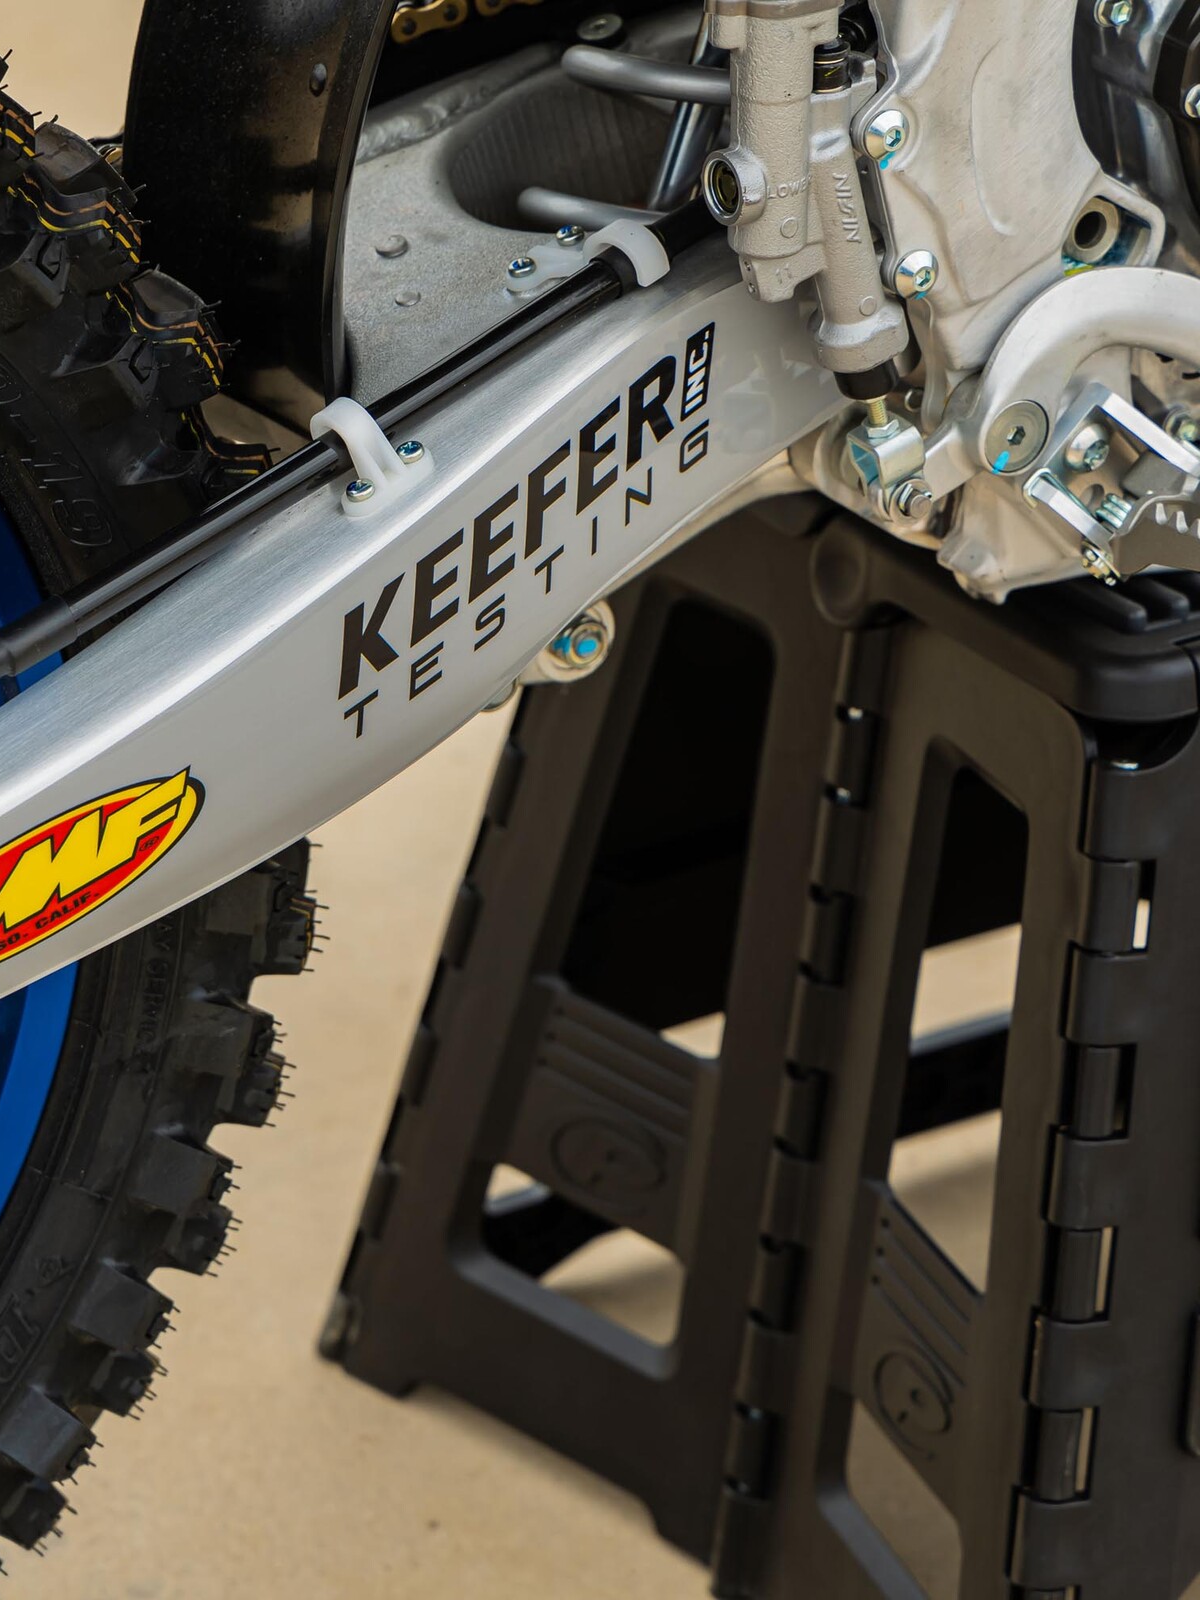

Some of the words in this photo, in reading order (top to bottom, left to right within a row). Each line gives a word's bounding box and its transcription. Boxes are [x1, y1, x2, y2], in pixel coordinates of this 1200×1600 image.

[766, 175, 812, 199] LOWE
[684, 327, 711, 415] INC.
[337, 354, 677, 700] KEEFER
[343, 418, 710, 739] TESTING
[34, 890, 100, 930] CALIF.
